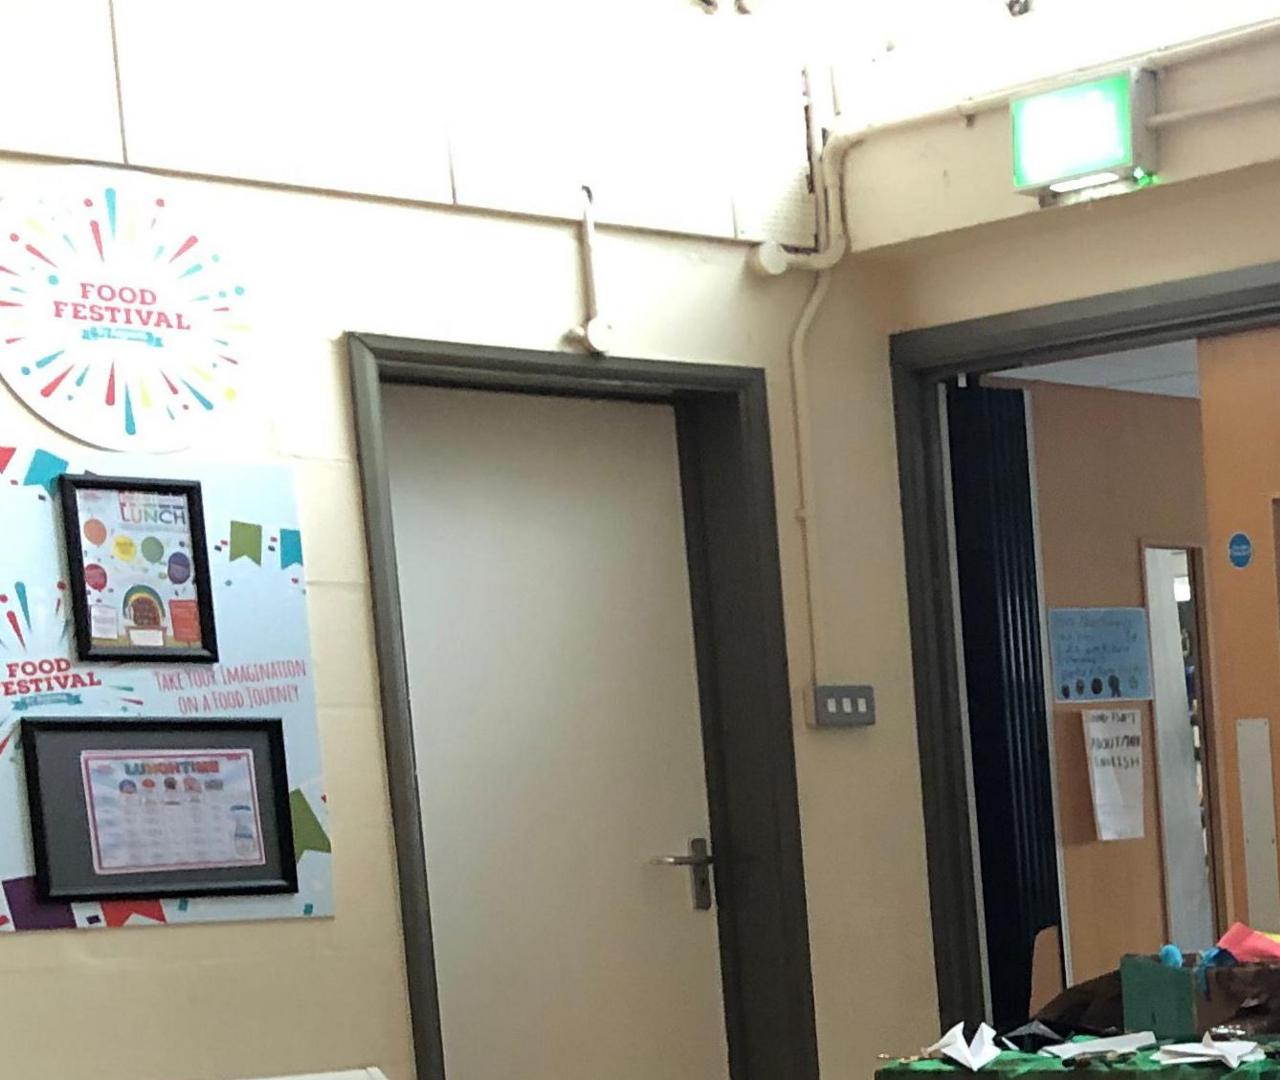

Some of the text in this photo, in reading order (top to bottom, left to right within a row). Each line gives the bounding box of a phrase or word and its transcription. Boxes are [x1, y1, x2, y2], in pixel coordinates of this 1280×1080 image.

[80, 282, 157, 305] FOOD
[53, 300, 191, 330] FESTIVAL
[120, 503, 186, 526] LUNCH
[6, 658, 71, 678] FOOD
[154, 660, 306, 692] TAKE YOUR IMAGINATION
[0, 671, 102, 696] ESTIVAL
[178, 684, 300, 714] ON A FOOD JOURNEY
